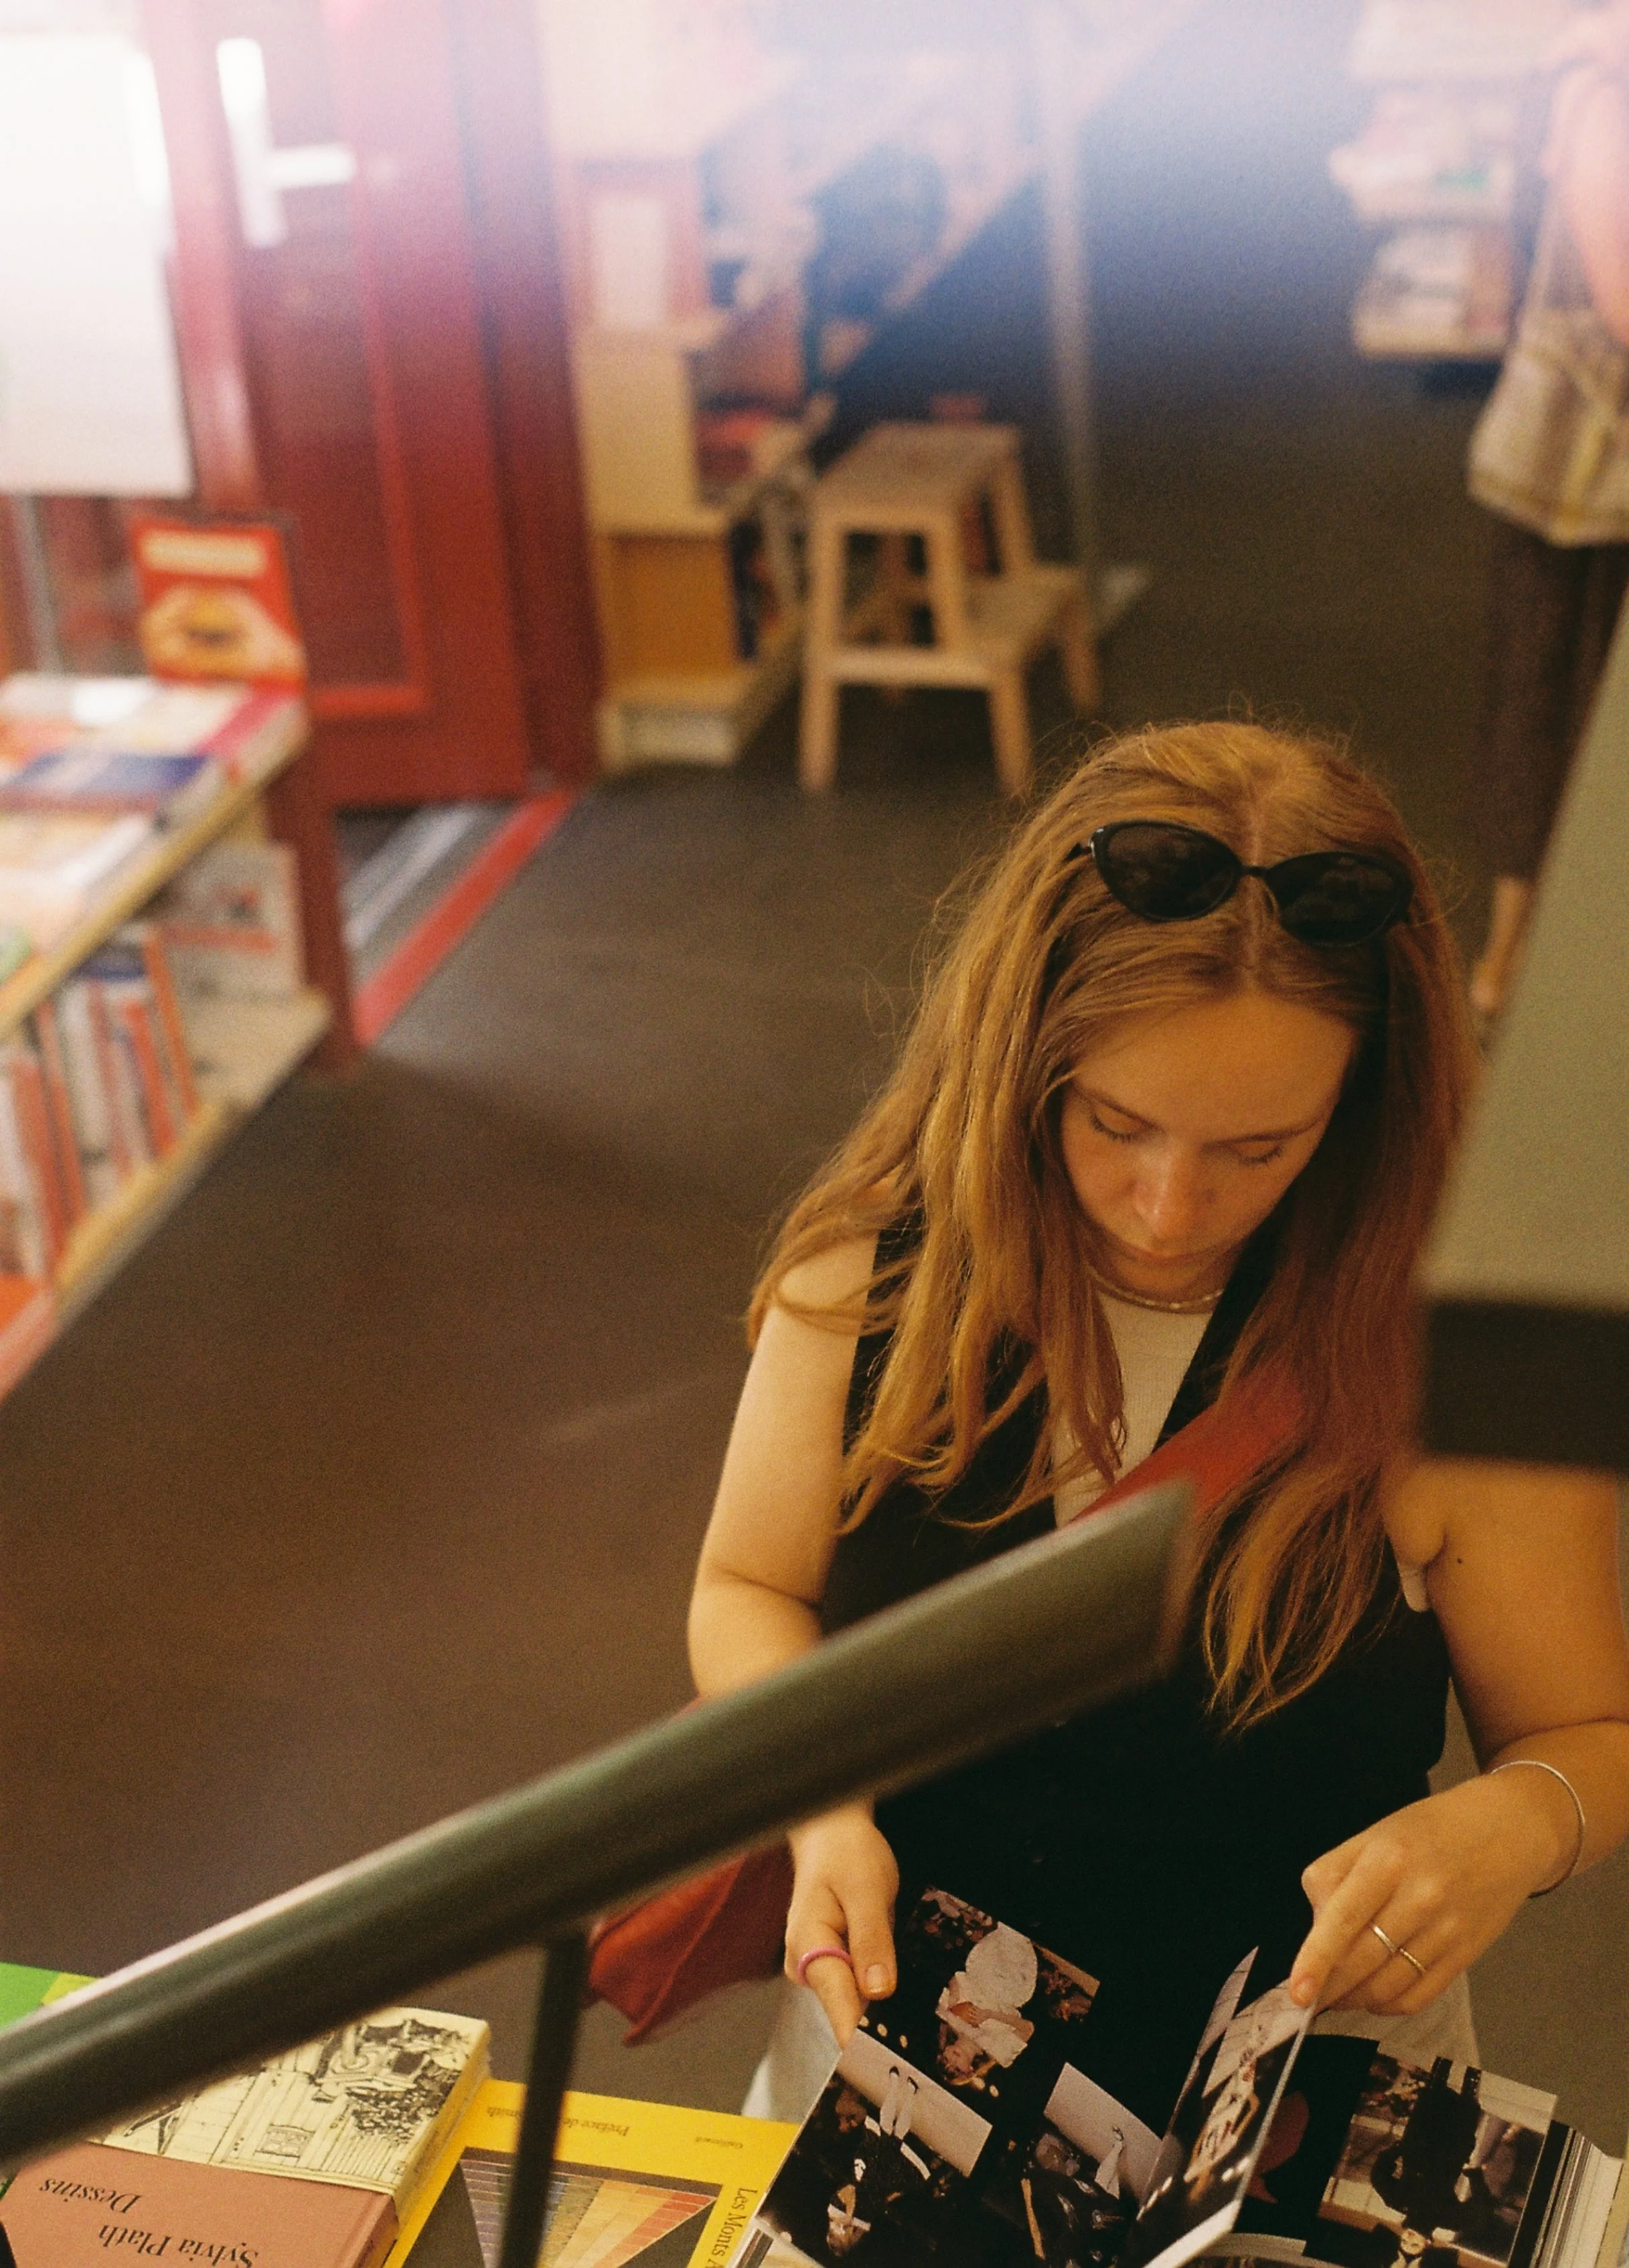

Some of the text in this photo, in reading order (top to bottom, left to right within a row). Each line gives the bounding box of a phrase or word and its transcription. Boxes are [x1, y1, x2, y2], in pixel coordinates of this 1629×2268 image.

[562, 2116, 578, 2129] de
[40, 2178, 141, 2214] Dessins
[732, 2188, 758, 2210] Les
[98, 2224, 259, 2268] Sylvia Plath
[712, 2213, 747, 2257] Monts
